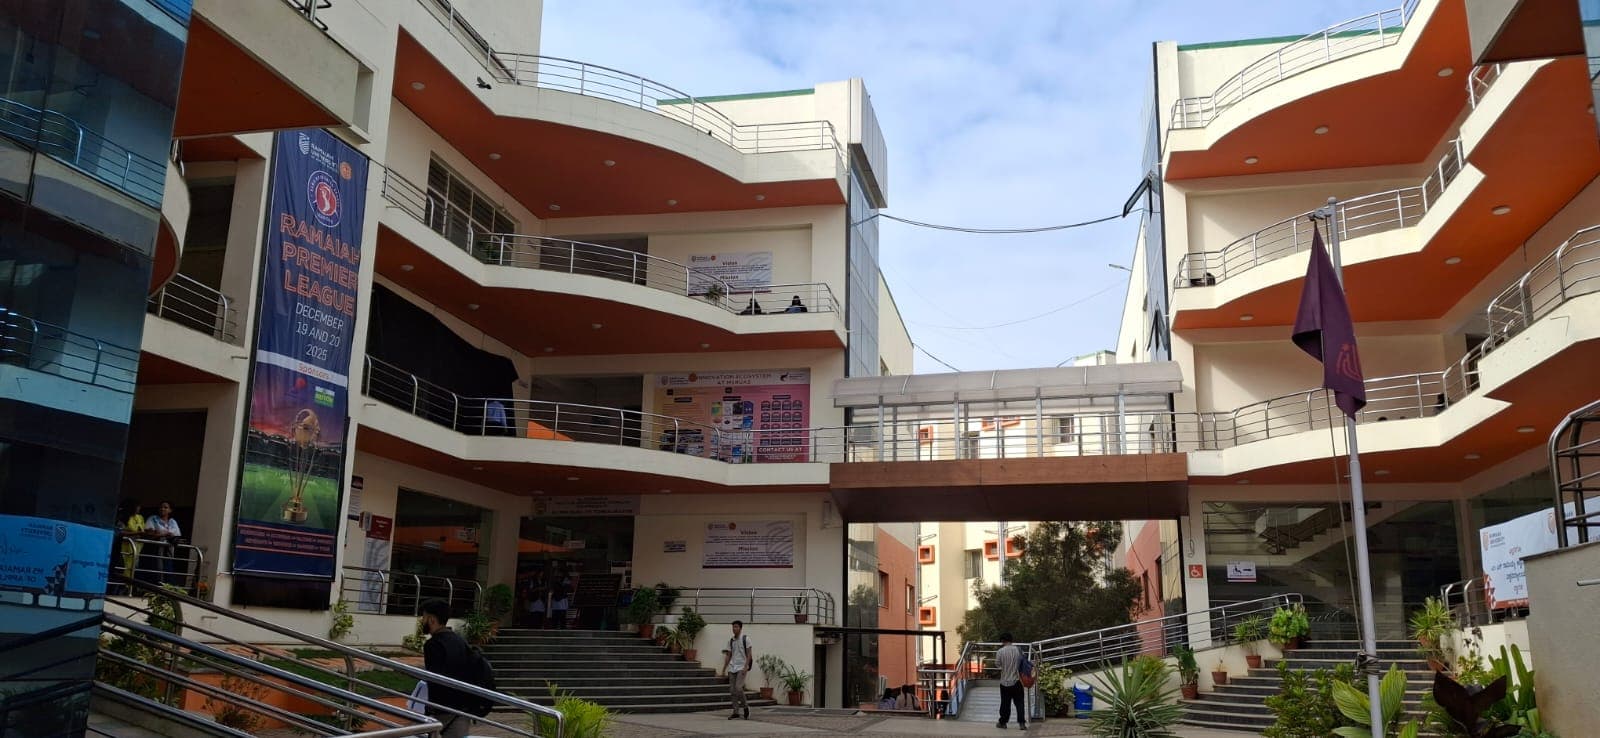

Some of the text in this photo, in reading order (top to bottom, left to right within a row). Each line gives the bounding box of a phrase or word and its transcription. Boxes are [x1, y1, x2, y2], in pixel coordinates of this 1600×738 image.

[280, 213, 360, 264] RAMAIAH
[282, 241, 358, 290] PREMIER
[284, 269, 355, 315] LEAGUE
[296, 302, 344, 329] DECEMBER
[296, 321, 341, 348] 19 AND 20
[306, 343, 328, 361] 2025
